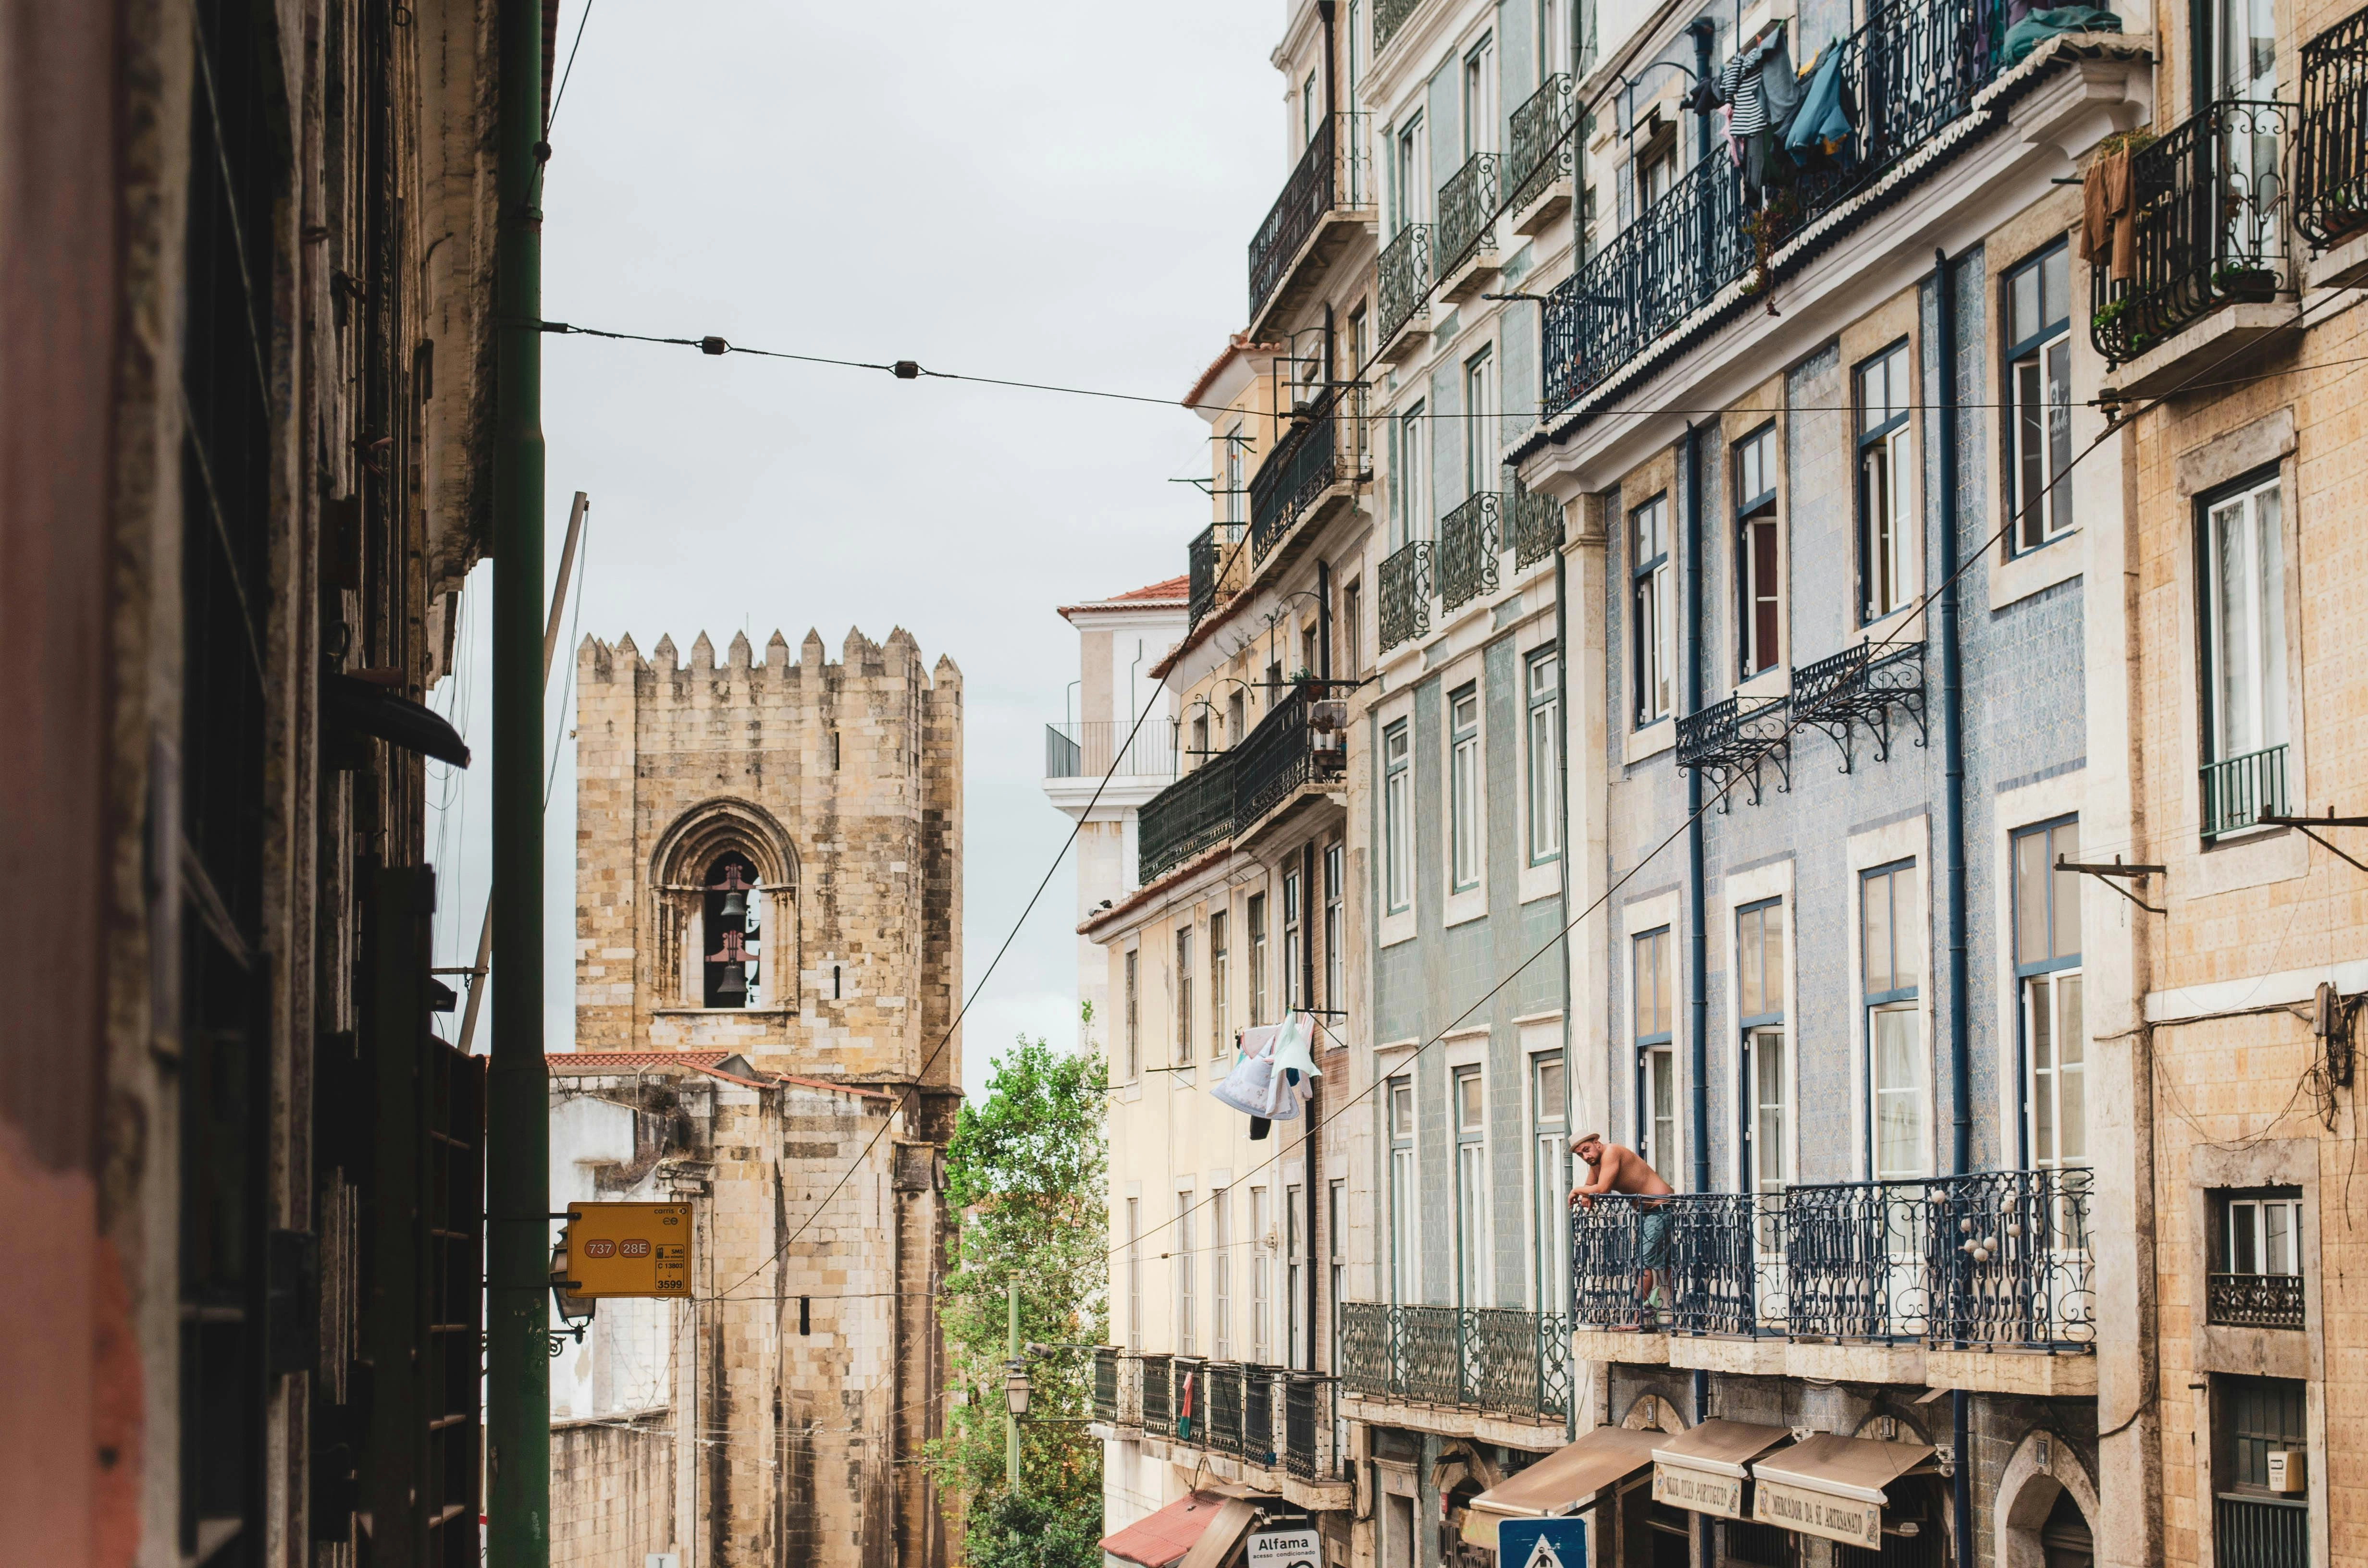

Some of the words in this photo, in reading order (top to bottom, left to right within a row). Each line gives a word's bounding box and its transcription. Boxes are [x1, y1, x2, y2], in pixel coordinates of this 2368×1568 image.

[589, 1244, 612, 1254] 737
[623, 1244, 647, 1253] 28E
[658, 1280, 682, 1289] 3599
[1772, 1495, 1802, 1520] MERCADOR
[1805, 1502, 1813, 1523] DA
[1815, 1500, 1822, 1525] SÉ
[1825, 1507, 1862, 1534] ARTESANATO
[1258, 1538, 1308, 1551] Alfama
